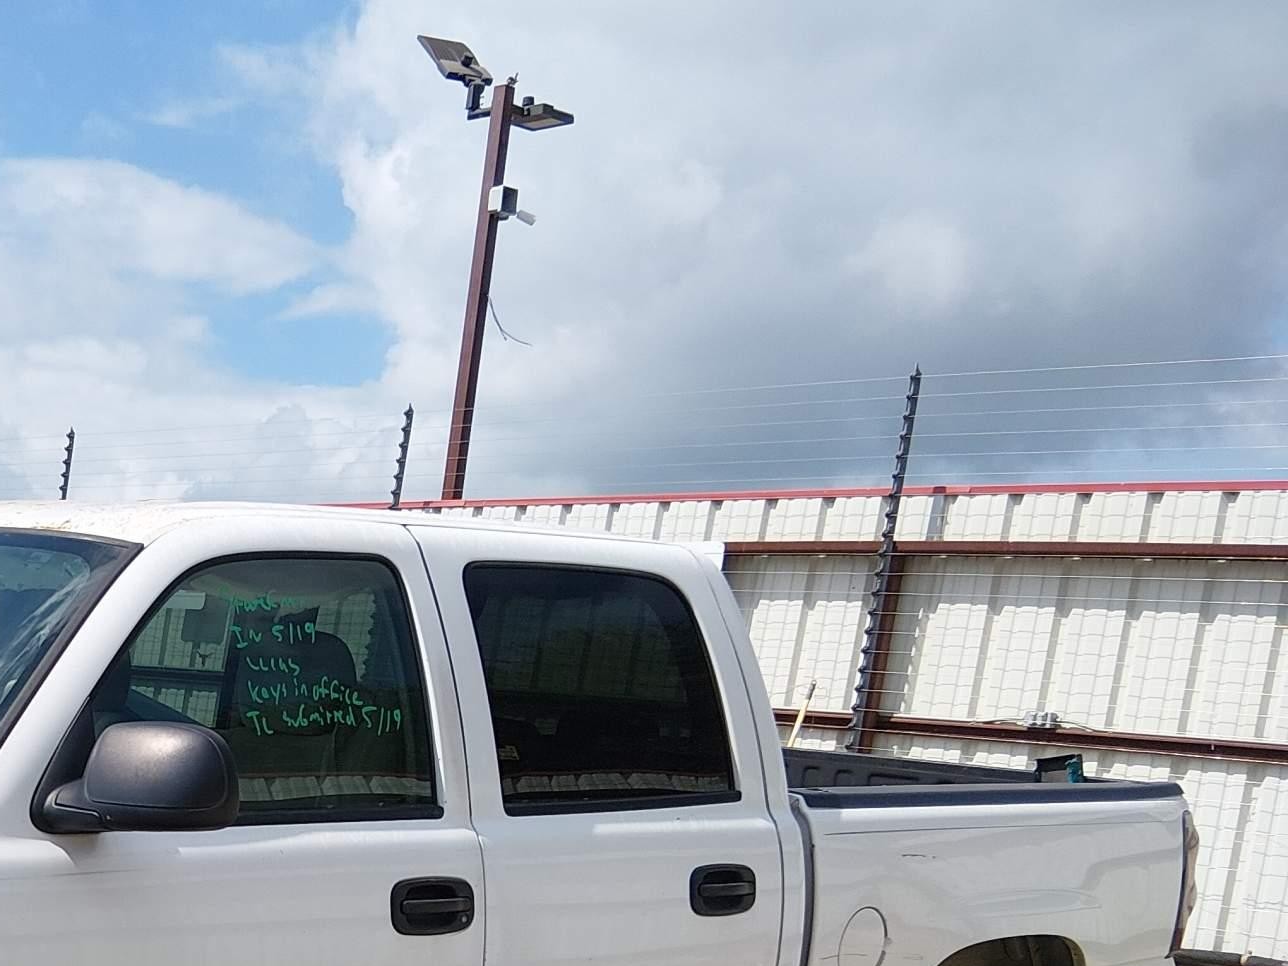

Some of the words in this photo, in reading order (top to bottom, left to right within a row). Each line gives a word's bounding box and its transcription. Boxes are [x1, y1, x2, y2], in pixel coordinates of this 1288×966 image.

[271, 621, 316, 645] 5/19
[293, 678, 308, 697] in
[312, 676, 363, 705] office
[361, 706, 402, 736] 5/19
